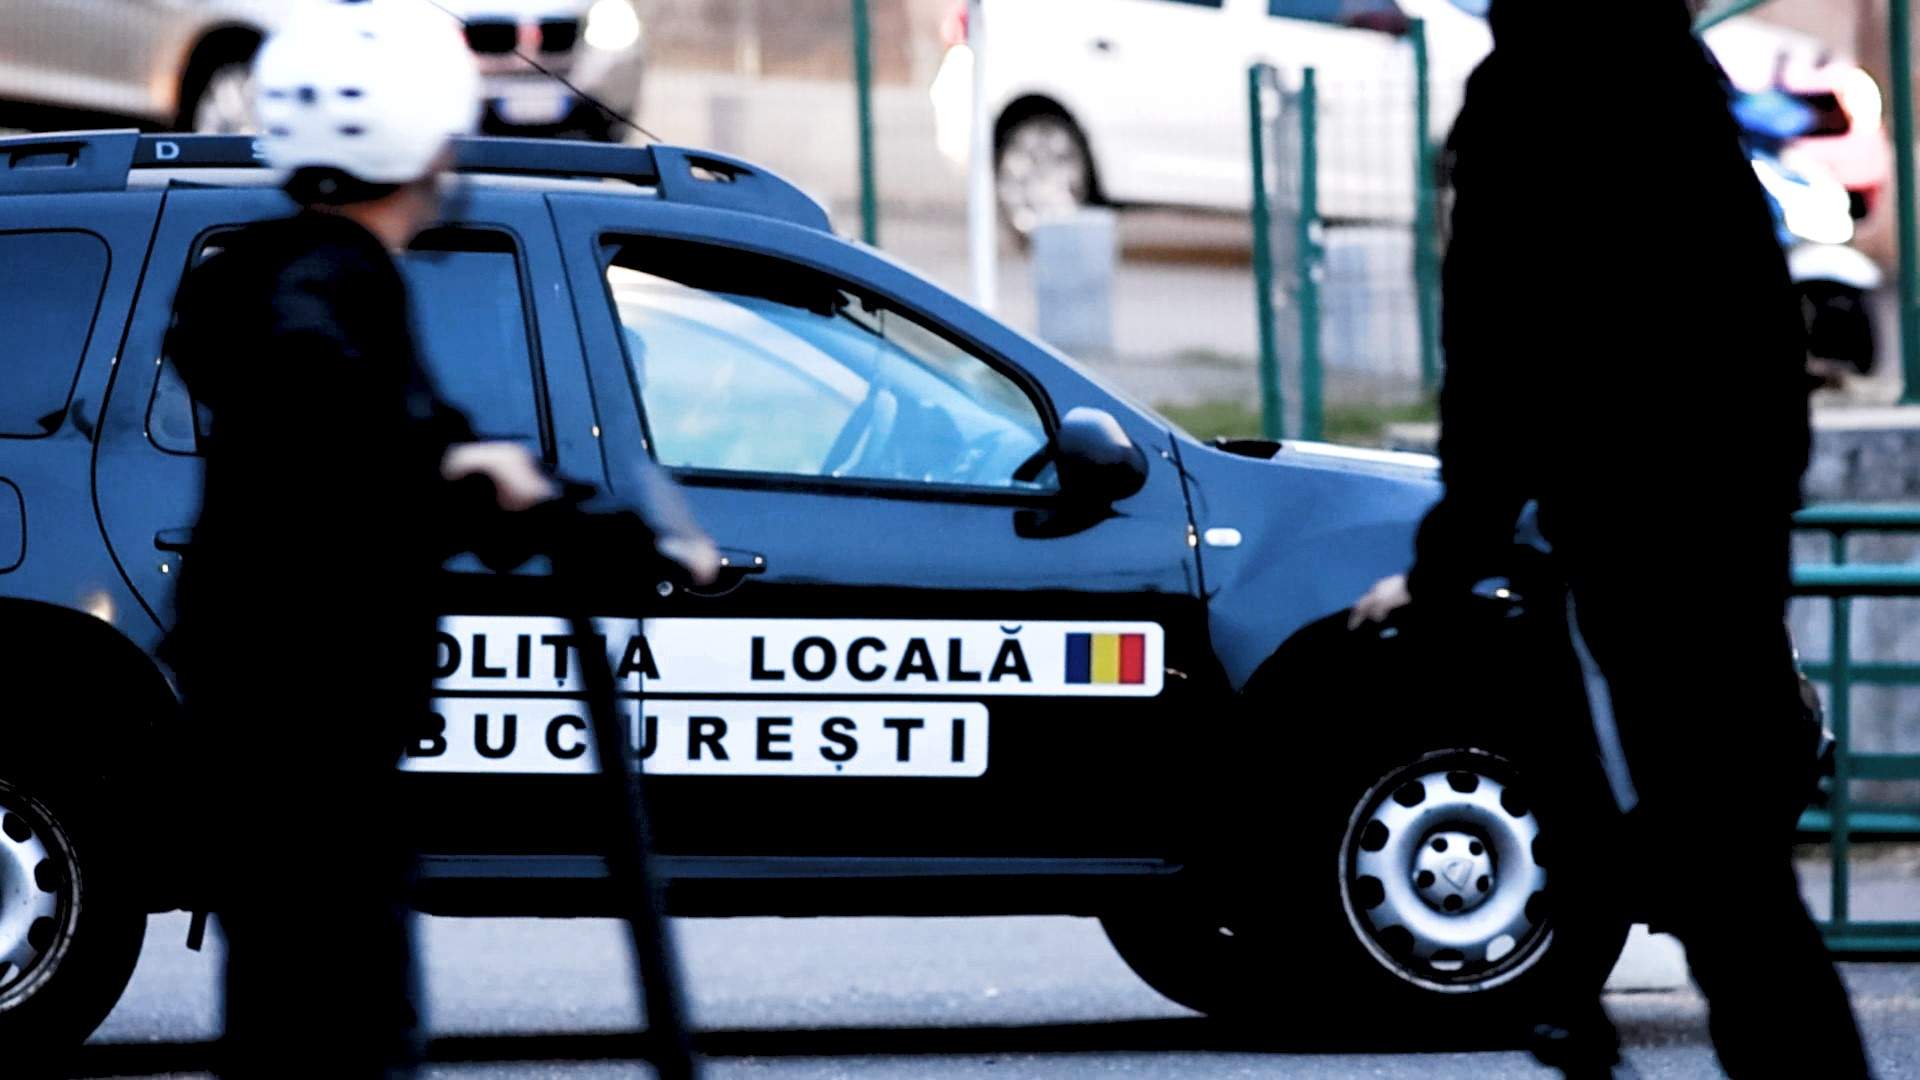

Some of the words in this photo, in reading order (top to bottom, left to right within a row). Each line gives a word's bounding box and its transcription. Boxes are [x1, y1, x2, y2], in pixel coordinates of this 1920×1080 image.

[432, 632, 660, 687] OLIȚA
[750, 625, 1032, 683] LOCALĂ
[405, 713, 965, 771] BUCUREȘTI
